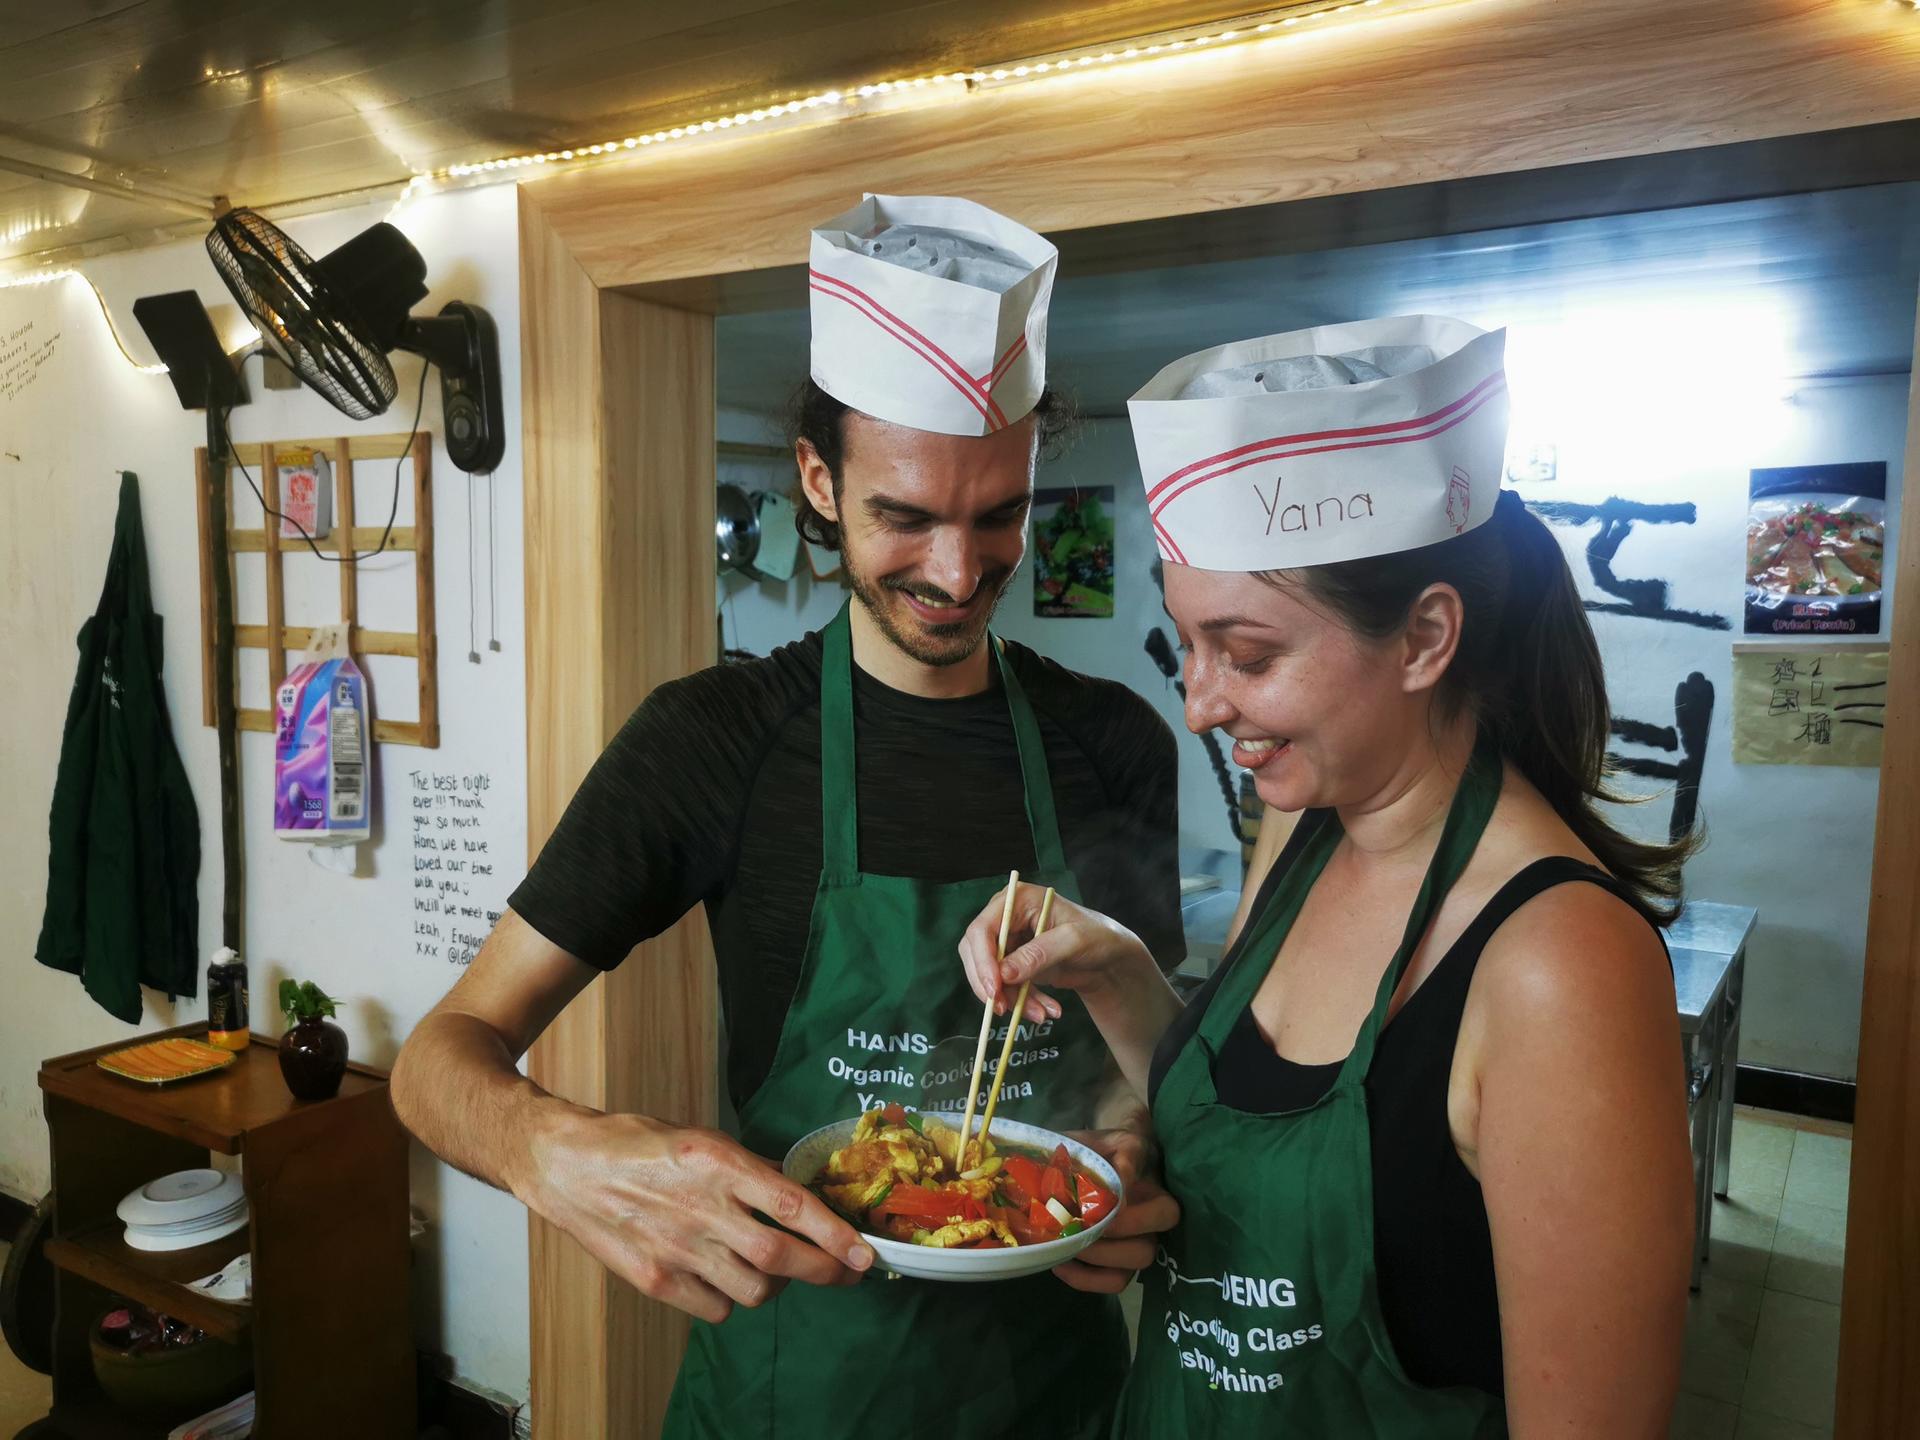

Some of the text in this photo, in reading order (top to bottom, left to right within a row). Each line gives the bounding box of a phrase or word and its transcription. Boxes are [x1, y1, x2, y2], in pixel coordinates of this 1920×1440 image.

[1253, 476, 1373, 535] Yana
[408, 770, 490, 796] The best night
[448, 796, 485, 808] Thank
[413, 815, 430, 832] you
[452, 816, 480, 828] much
[464, 838, 488, 853] have
[447, 859, 467, 872] our
[472, 860, 493, 875] time
[414, 875, 460, 899] with you
[461, 906, 483, 919] meet
[452, 927, 486, 952] Englan
[847, 1028, 928, 1055] HANS
[828, 1056, 915, 1088] Organic
[1008, 1046, 1060, 1067] Class
[1247, 1324, 1324, 1352] Class
